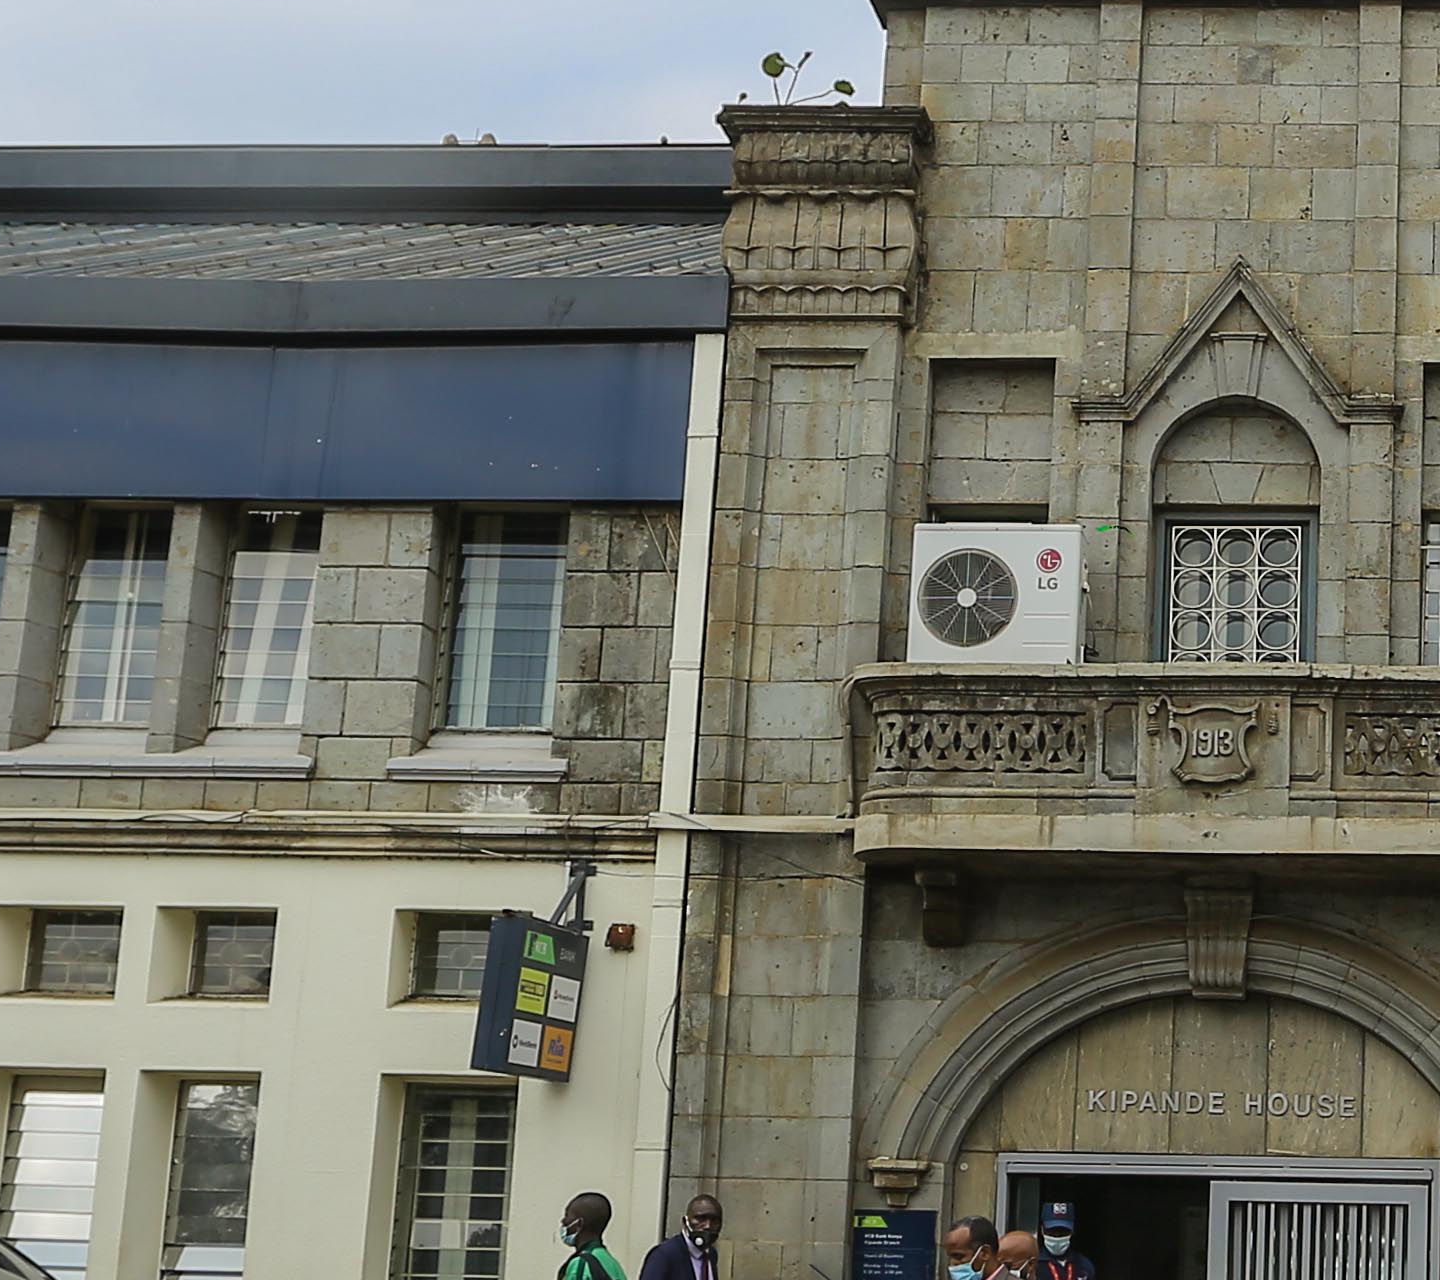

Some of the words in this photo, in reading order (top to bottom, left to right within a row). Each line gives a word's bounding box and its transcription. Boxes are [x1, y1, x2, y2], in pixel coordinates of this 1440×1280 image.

[1037, 577, 1059, 590] LG
[1191, 727, 1235, 758] 1913
[1087, 1089, 1226, 1115] KIPANDE
[1243, 1092, 1357, 1118] HOUSE
